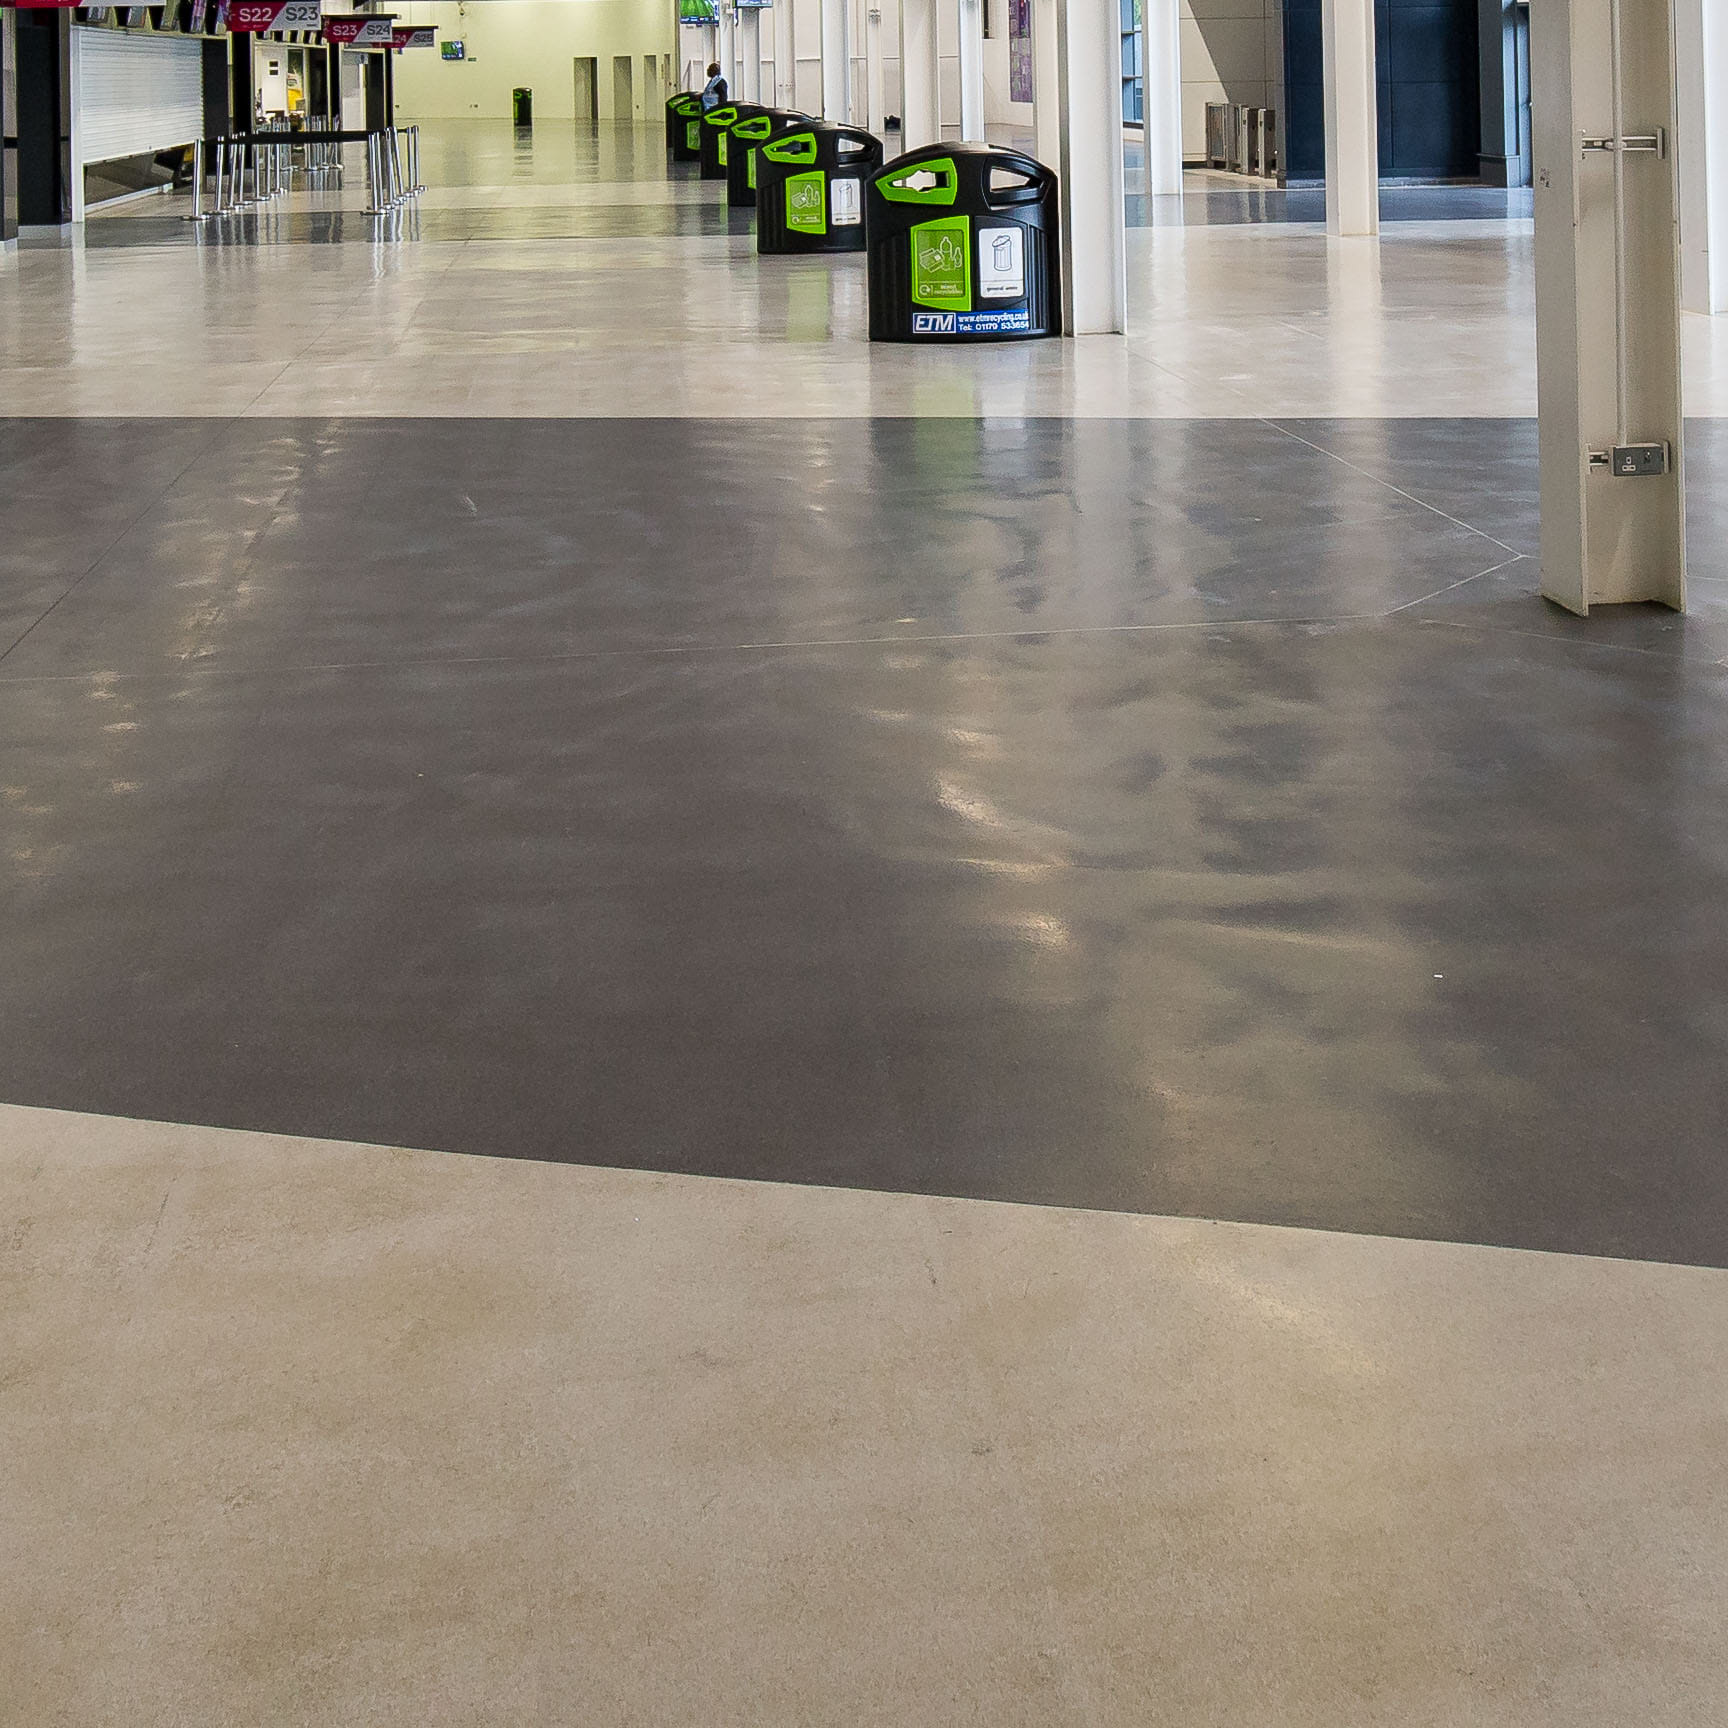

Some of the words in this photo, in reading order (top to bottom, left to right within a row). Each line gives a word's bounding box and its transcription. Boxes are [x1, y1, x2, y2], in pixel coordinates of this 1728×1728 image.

[239, 8, 272, 22] S22
[285, 6, 319, 21] S23
[332, 25, 358, 36] S23
[366, 25, 391, 36] S24
[915, 315, 954, 331] ETM
